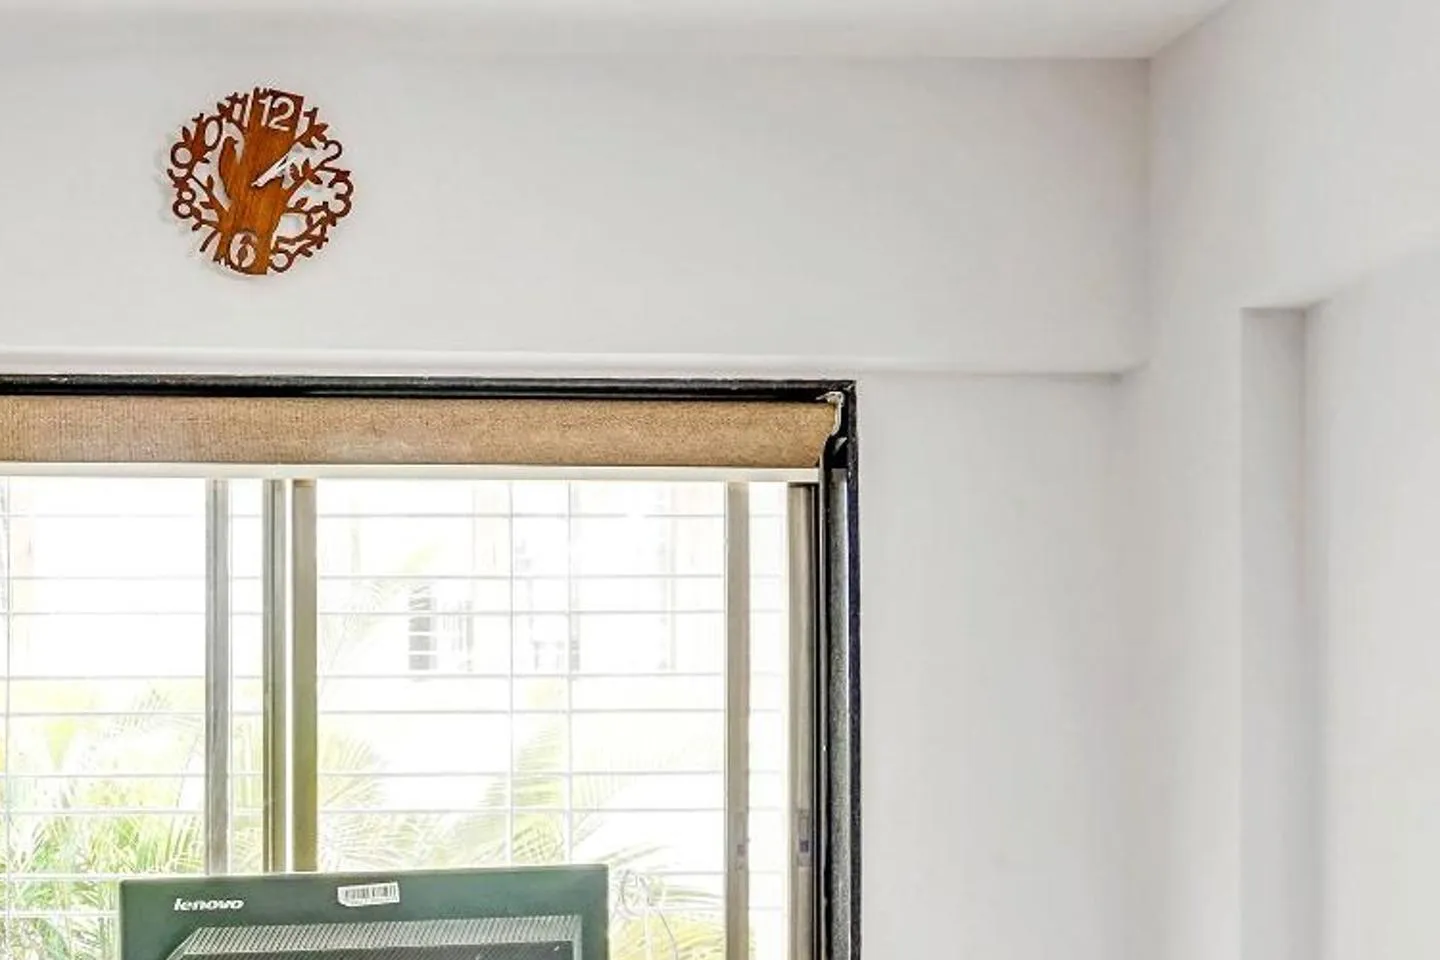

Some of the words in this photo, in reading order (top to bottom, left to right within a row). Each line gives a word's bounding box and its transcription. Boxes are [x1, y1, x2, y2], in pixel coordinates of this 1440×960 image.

[259, 96, 296, 131] 12
[192, 113, 224, 152] 10
[167, 142, 194, 180] 9
[322, 140, 351, 176] 2
[172, 188, 197, 219] 8
[327, 172, 355, 217] 3
[229, 232, 258, 268] 6
[174, 898, 244, 911] lenovo
